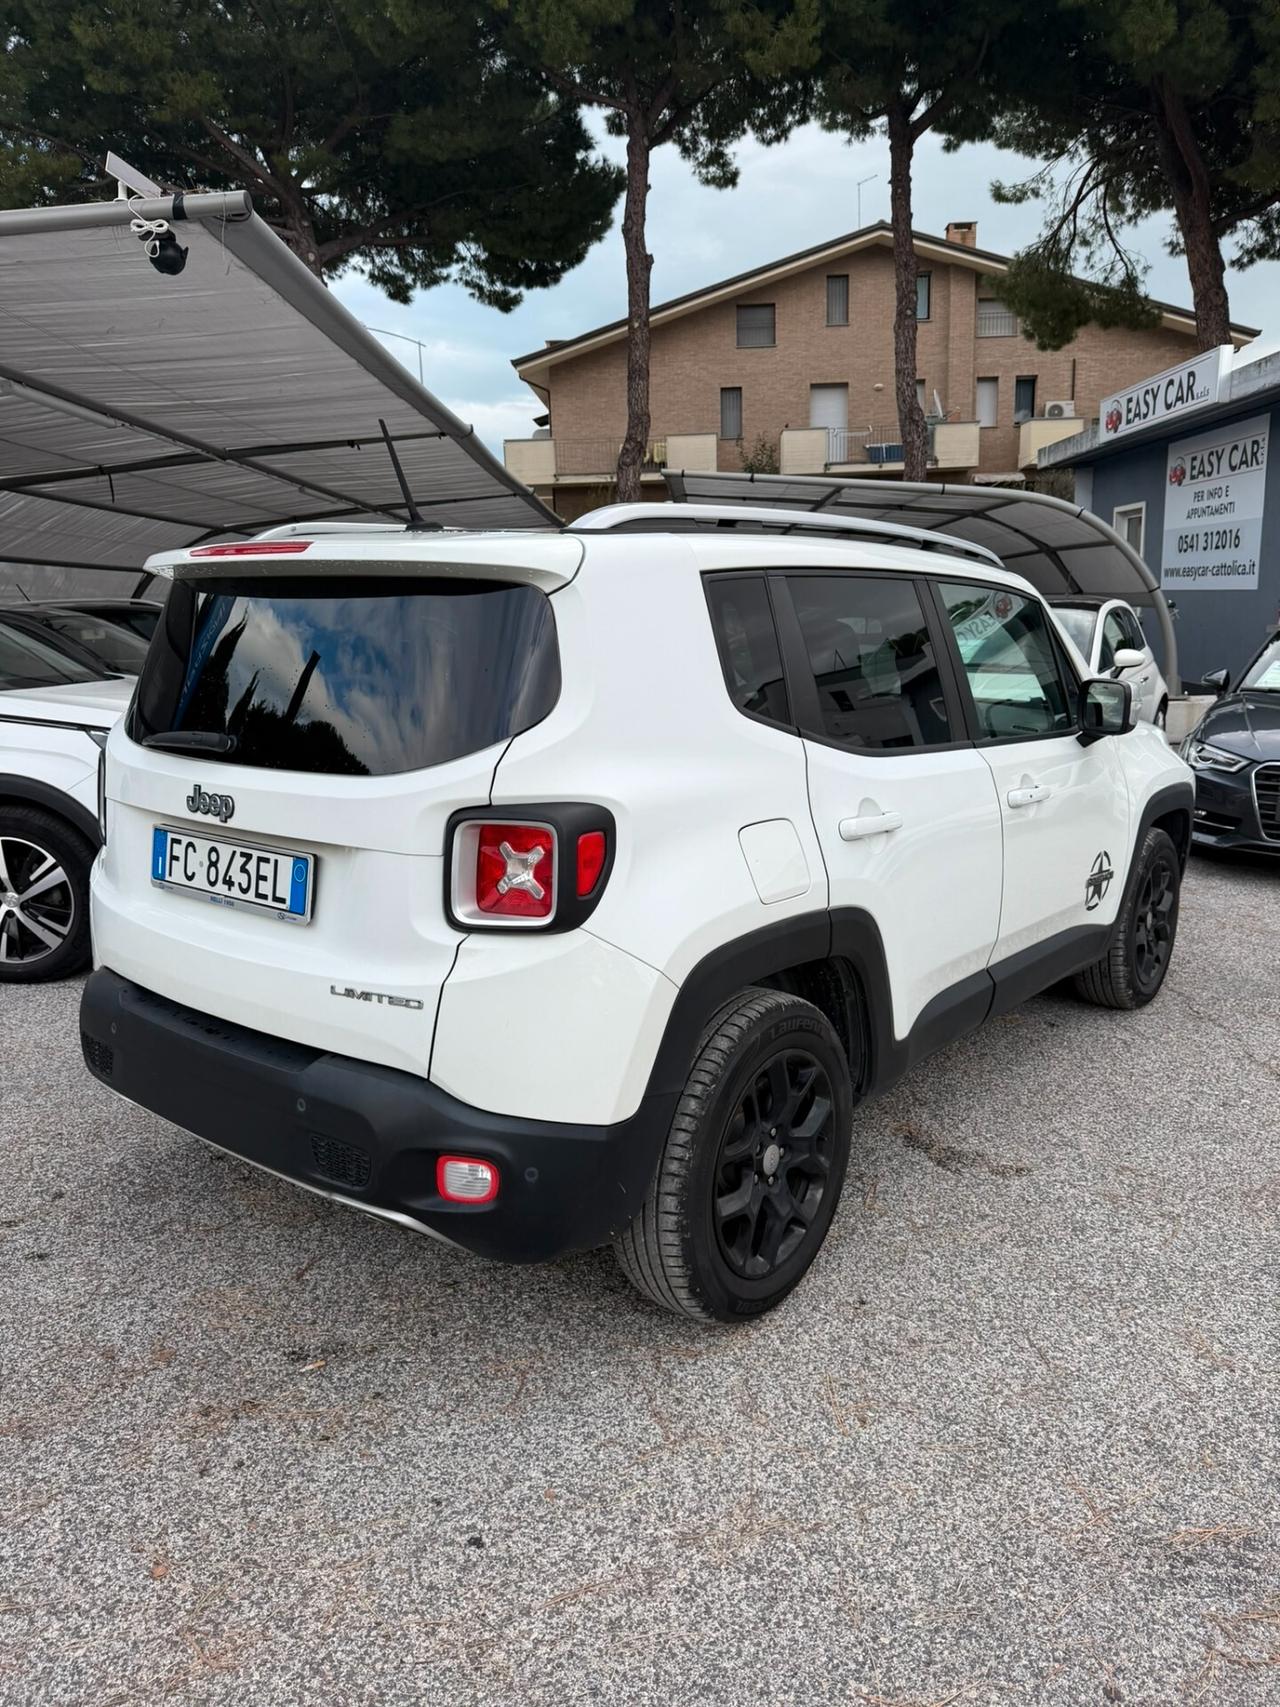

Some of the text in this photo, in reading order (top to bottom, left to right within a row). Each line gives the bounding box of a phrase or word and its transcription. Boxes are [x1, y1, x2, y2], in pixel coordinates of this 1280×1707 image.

[1125, 384, 1161, 425] EASY
[1164, 370, 1196, 411] CAR
[1189, 447, 1225, 480] EASY
[1228, 440, 1259, 472] CAR
[1193, 484, 1230, 503] PER INFO E
[1186, 501, 1236, 520] APPUNTAMENTI
[1178, 528, 1241, 554] 0541 312016
[1163, 560, 1257, 581] www.easycar-cattolica.it
[186, 784, 235, 823] Jeep
[167, 837, 287, 905] FC 843EL
[330, 985, 424, 1011] LIMITED
